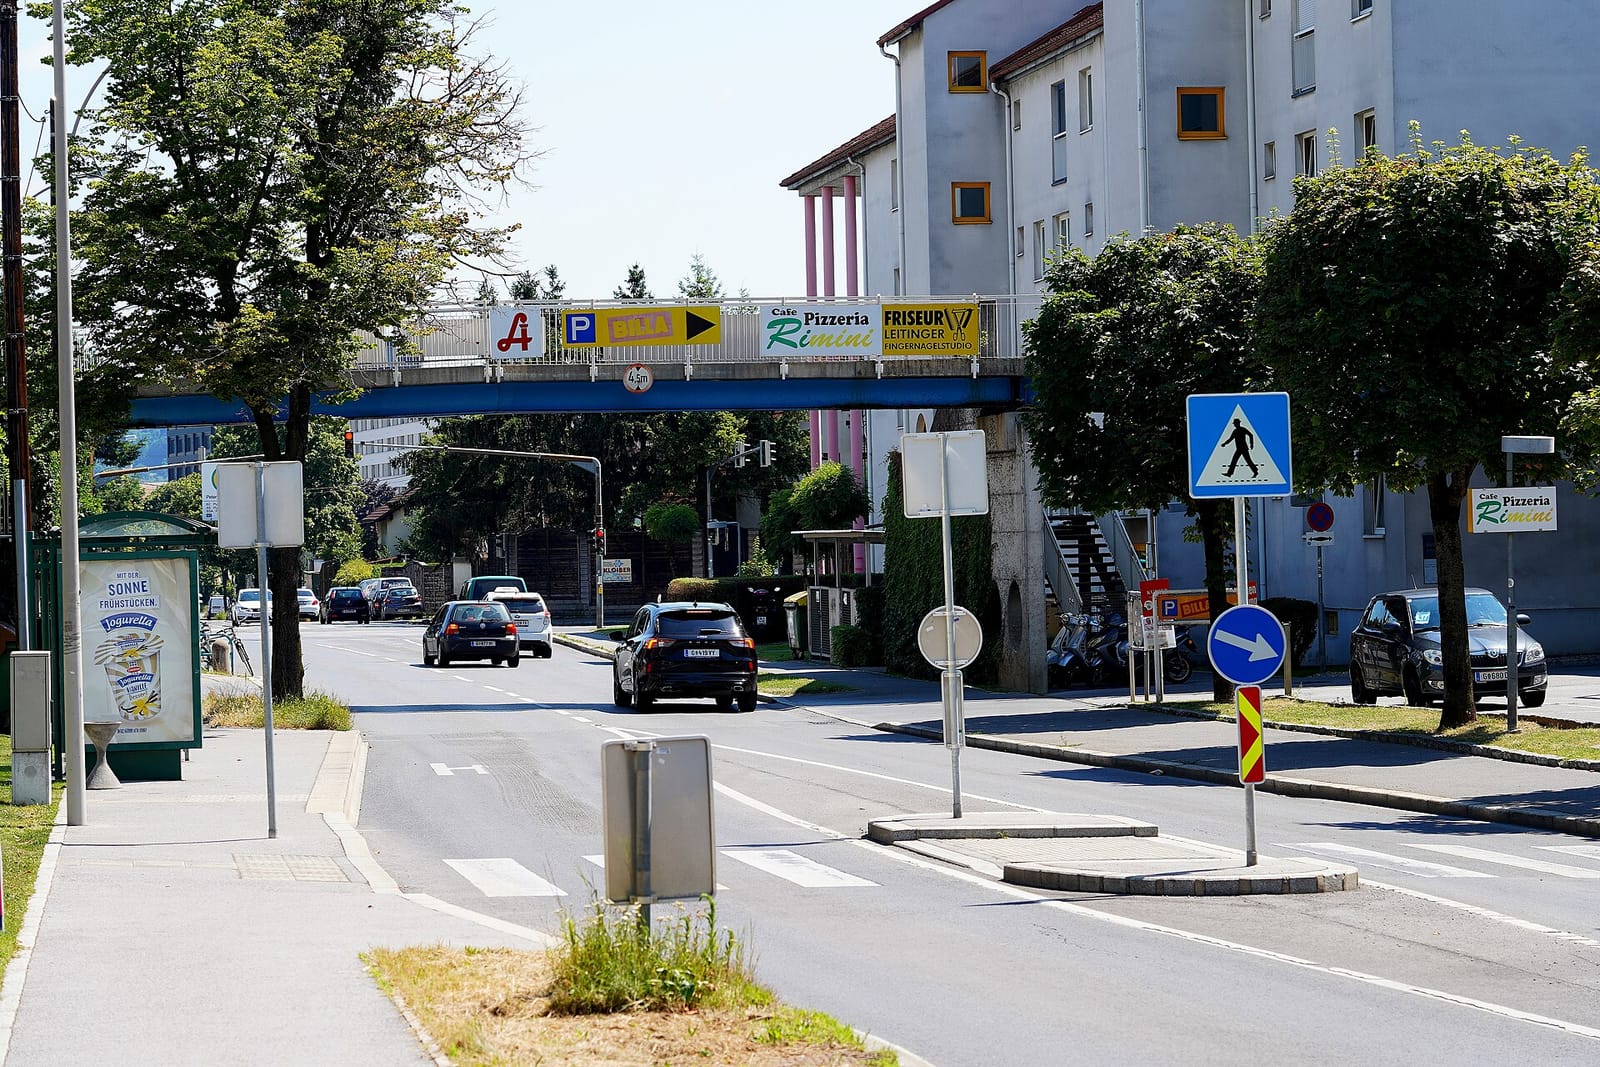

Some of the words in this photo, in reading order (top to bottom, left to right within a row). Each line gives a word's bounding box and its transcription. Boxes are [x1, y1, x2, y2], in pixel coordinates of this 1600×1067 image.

[771, 308, 798, 316] Cafe
[804, 311, 869, 326] Pizzeria
[884, 310, 944, 326] FRISEUR
[571, 316, 590, 341] P
[612, 316, 668, 339] BILLA
[766, 317, 874, 350] Rimini
[884, 328, 945, 339] LEITINGER
[884, 342, 972, 350] FINGERNAGELSTUDIO
[628, 372, 648, 384] 4,5m
[1502, 495, 1551, 507] Pizzeria
[1476, 500, 1553, 525] Rimini
[108, 580, 148, 596] SONNE
[99, 598, 157, 609] FRÜHSTÜCKEN.
[1164, 600, 1175, 616] P
[106, 615, 153, 631] Jogurella
